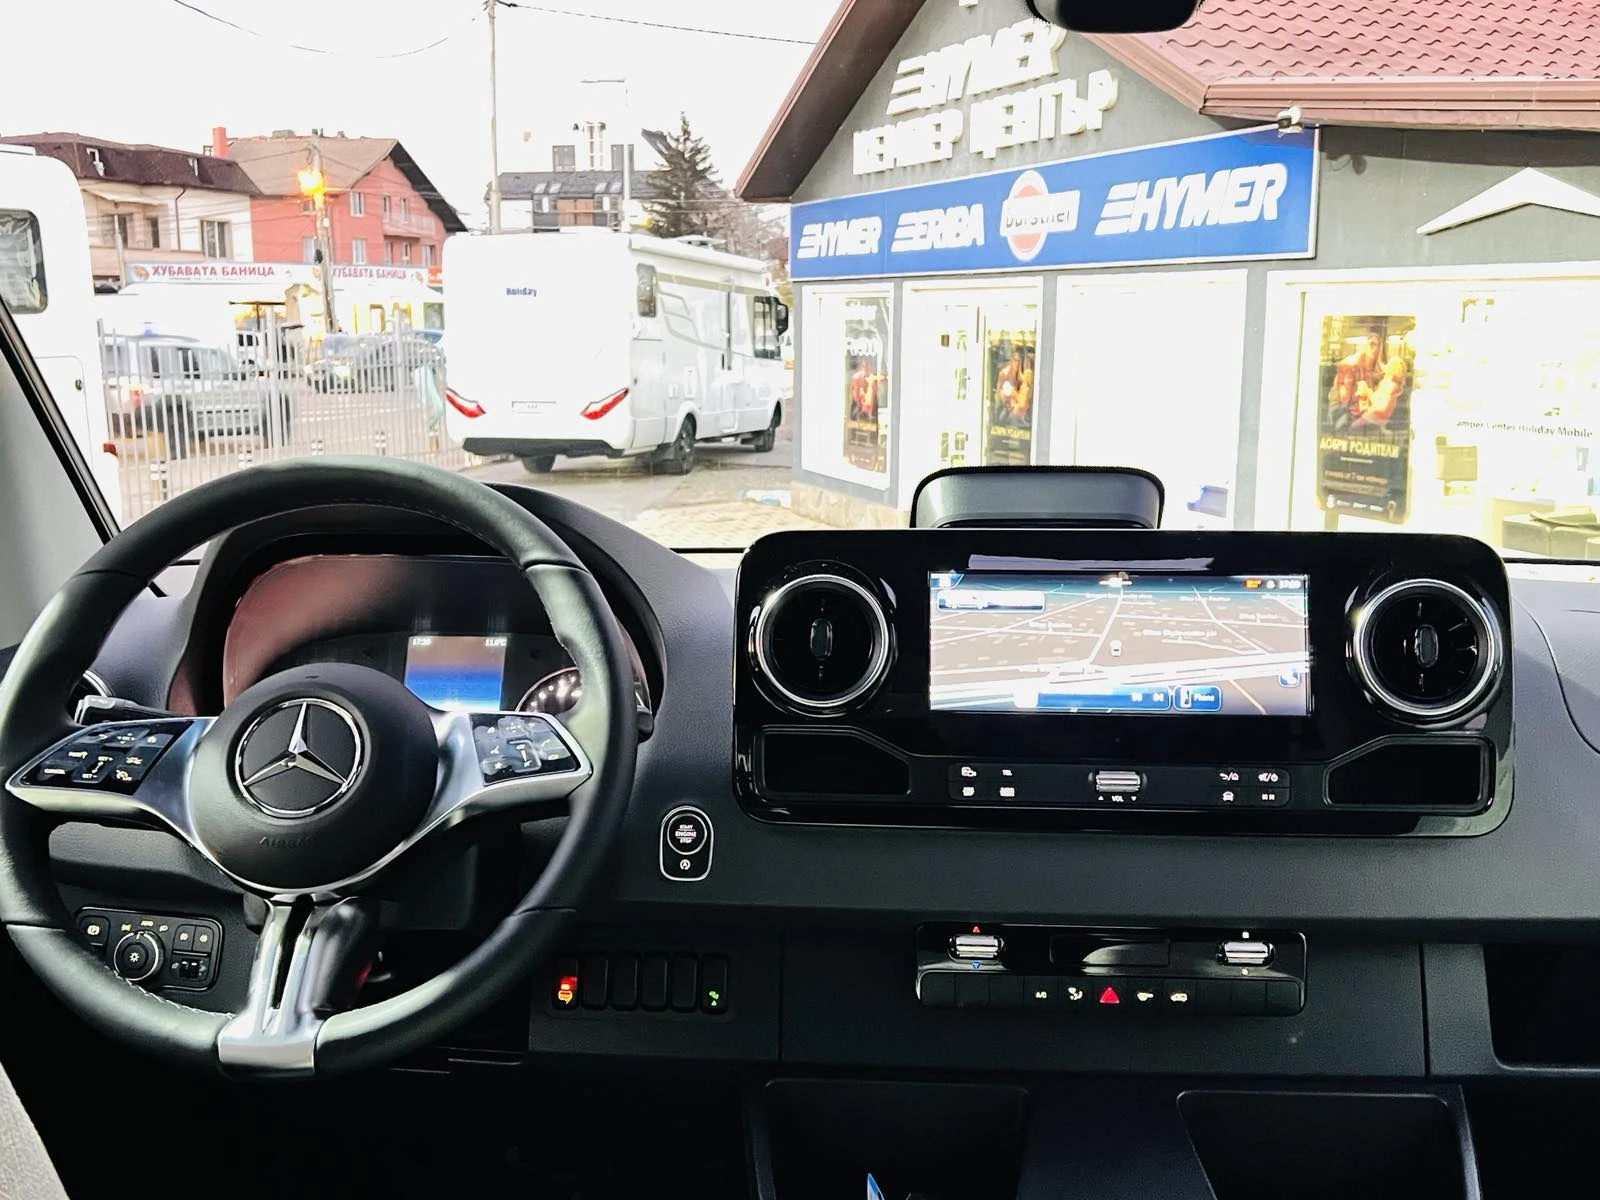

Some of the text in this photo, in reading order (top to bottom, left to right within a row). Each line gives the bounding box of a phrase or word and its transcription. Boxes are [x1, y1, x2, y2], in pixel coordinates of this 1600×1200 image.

[970, 70, 1119, 159] ЦЕНТЪР
[1094, 163, 1288, 235] HYMER
[797, 216, 882, 258] HYMER
[891, 203, 985, 252] ERBA
[151, 265, 275, 277] ХУБАВАТА БАНИЦА
[1456, 420, 1484, 429] amper
[1558, 426, 1593, 438] Mobile
